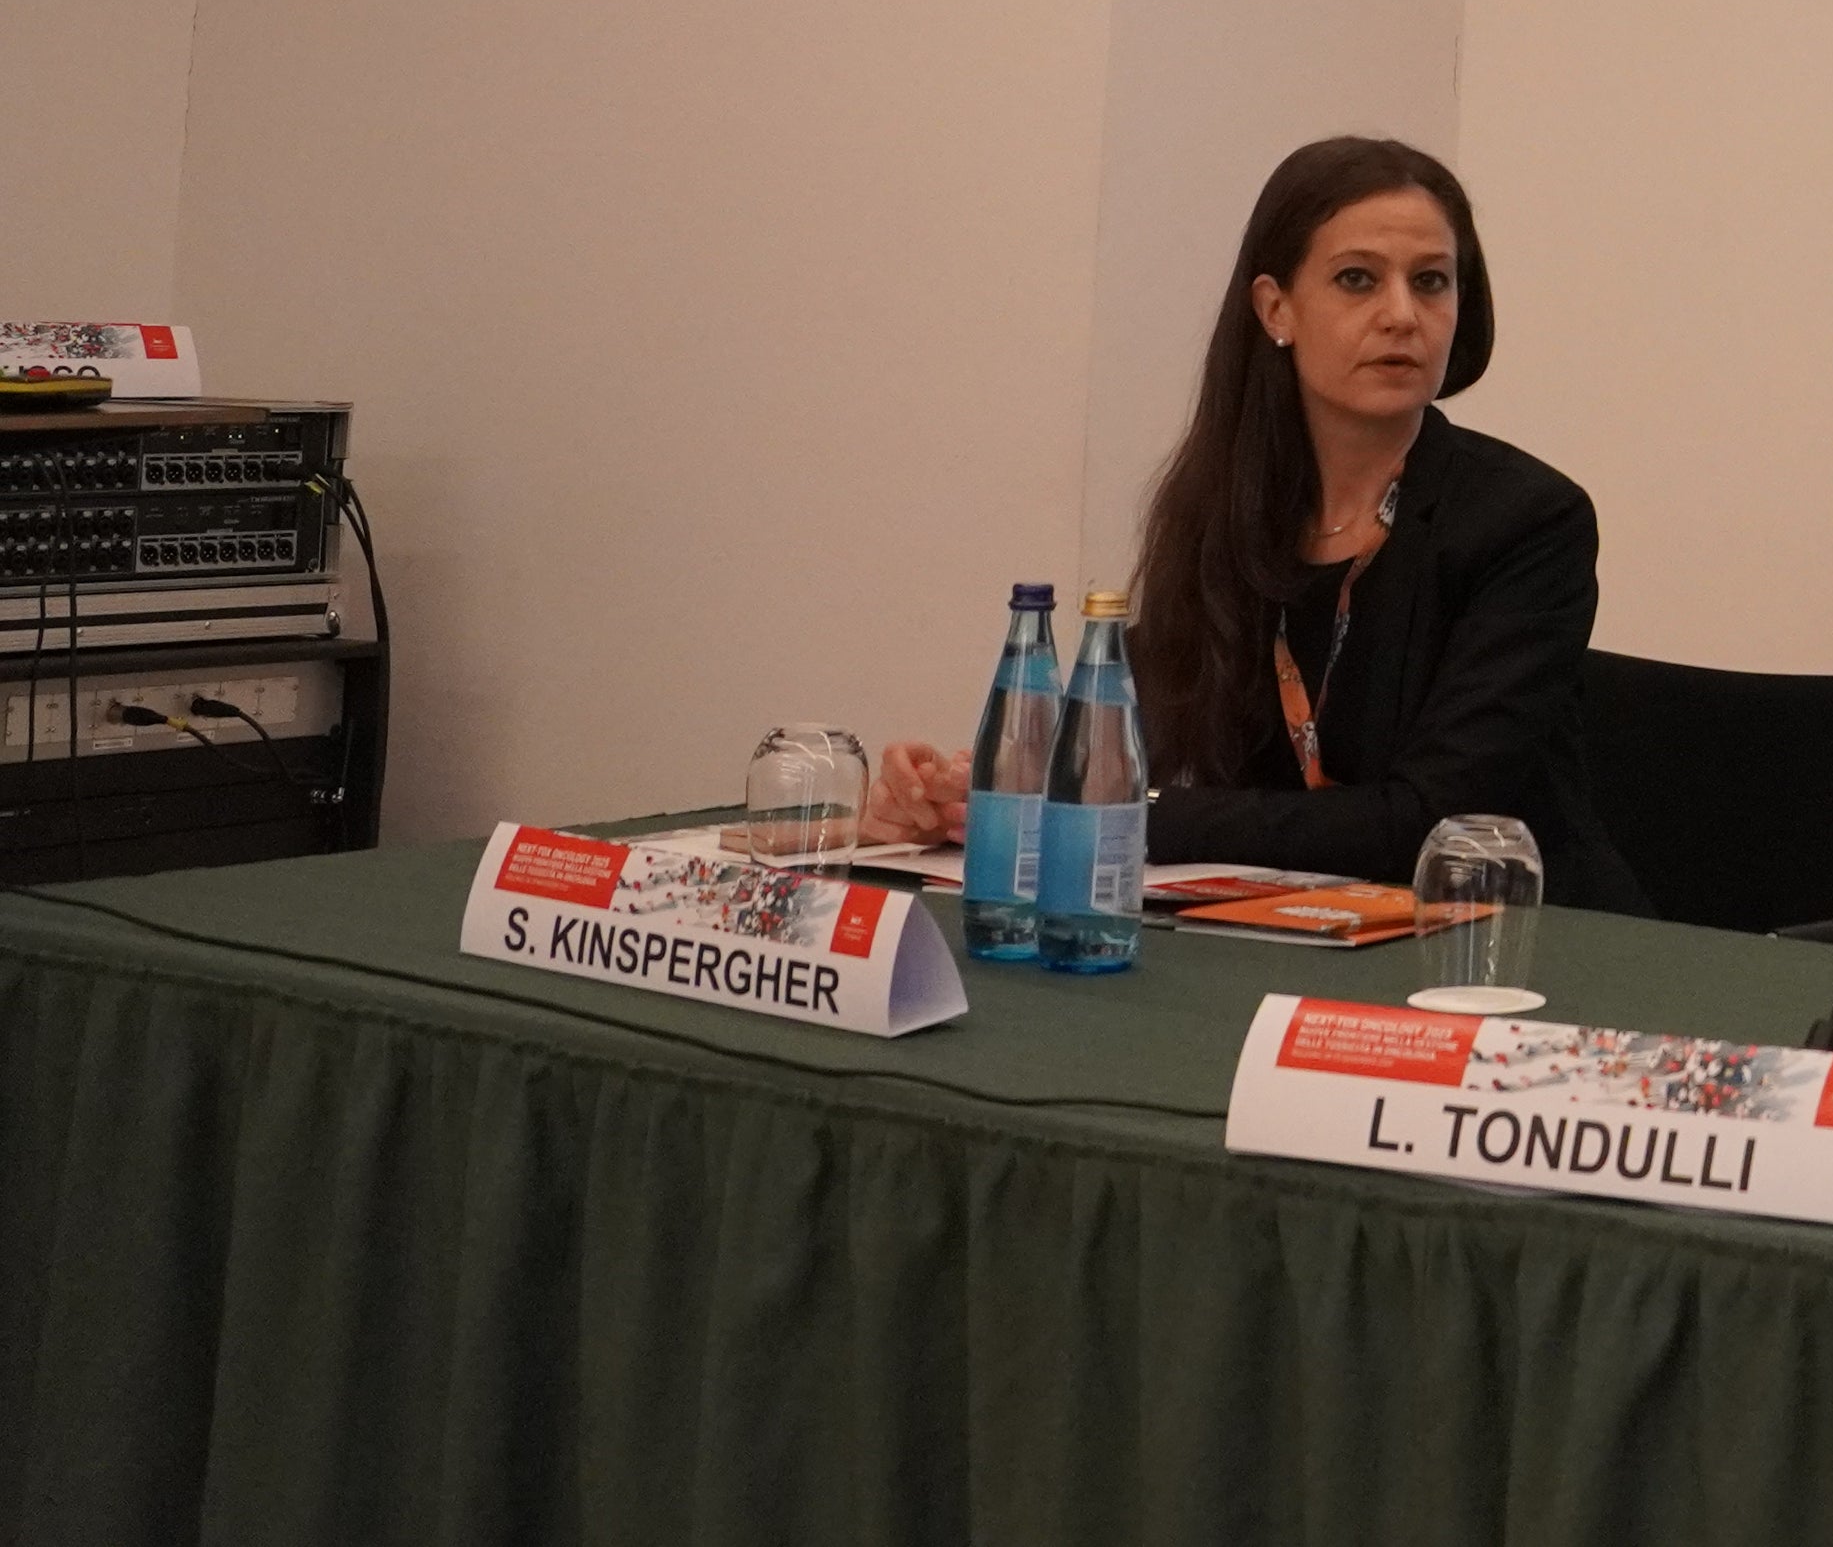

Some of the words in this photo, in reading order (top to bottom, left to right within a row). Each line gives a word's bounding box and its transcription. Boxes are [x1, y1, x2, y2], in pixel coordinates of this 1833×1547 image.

[505, 907, 535, 954] S.
[551, 915, 839, 1014] KINSPERGHER
[1368, 1098, 1413, 1151] L.
[1443, 1105, 1757, 1192] TONDULLI
